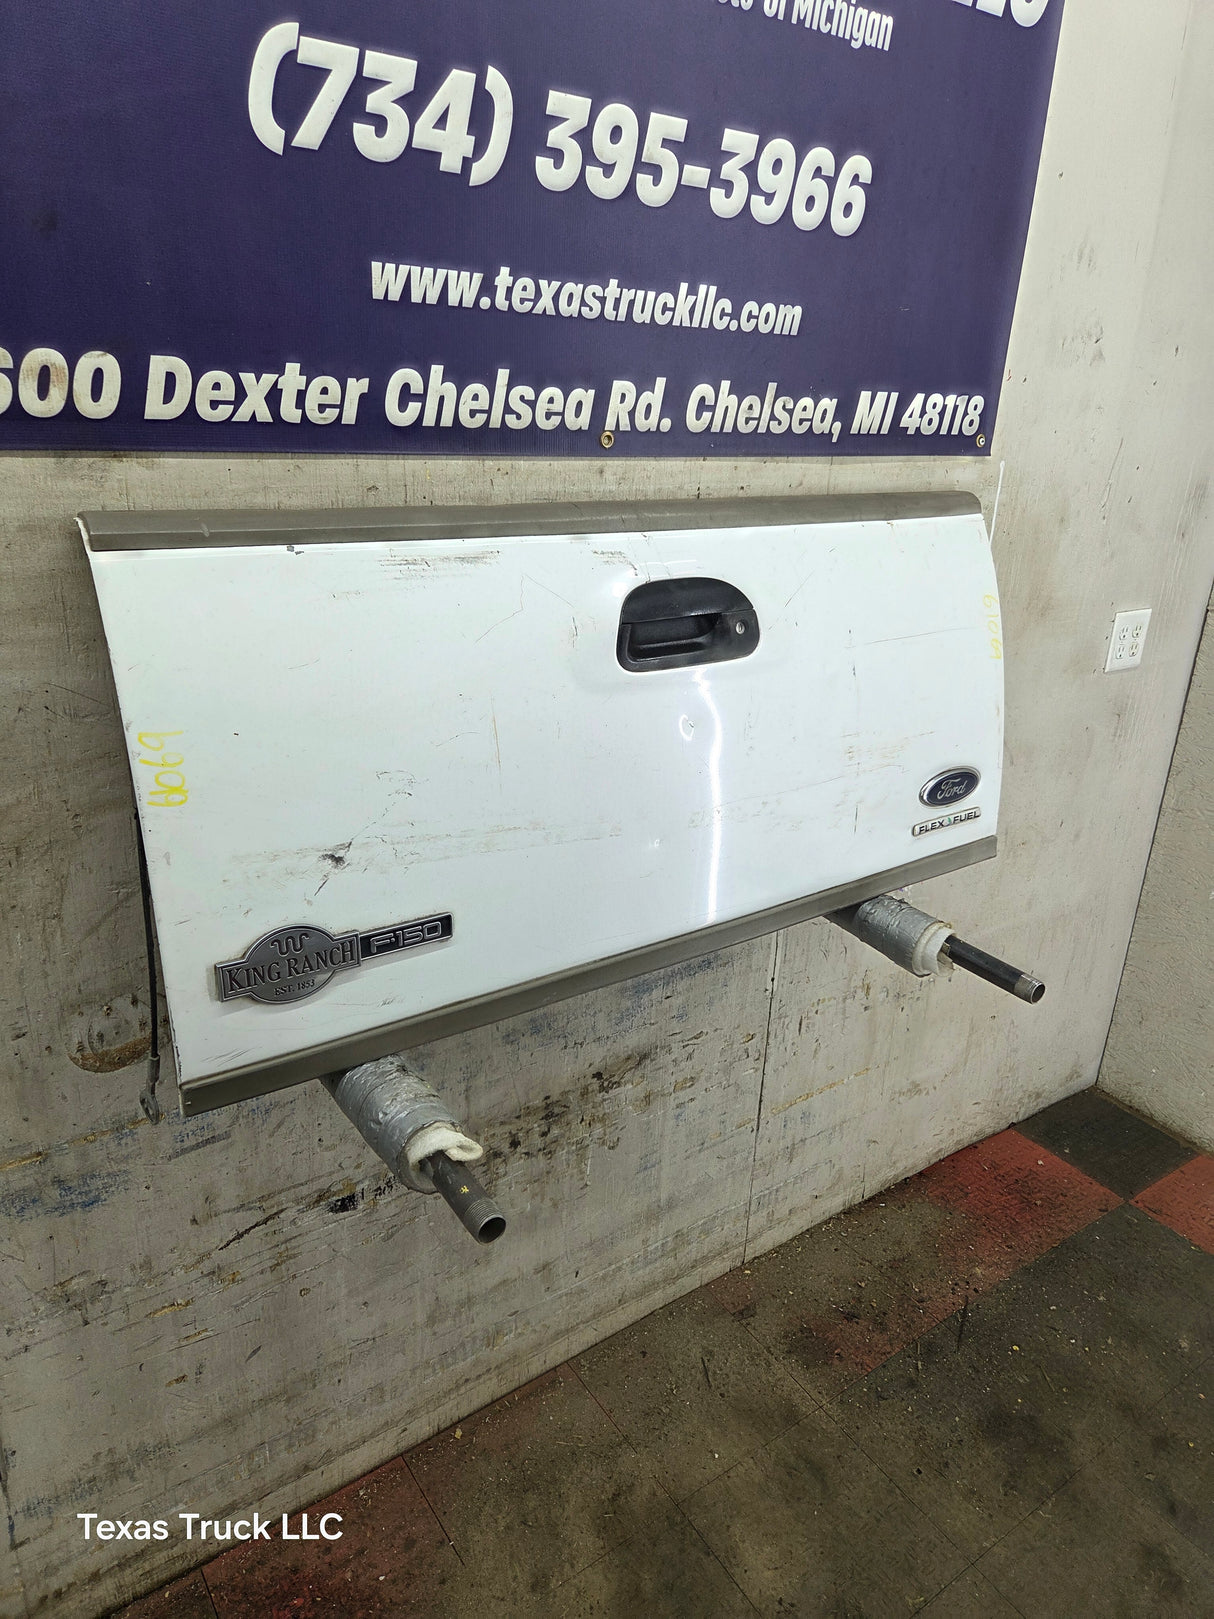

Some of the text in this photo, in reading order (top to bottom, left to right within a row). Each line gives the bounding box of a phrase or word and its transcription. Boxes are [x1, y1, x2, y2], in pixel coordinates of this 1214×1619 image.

[791, 0, 894, 52] Michigan
[248, 21, 874, 238] (734) 395-3966
[370, 260, 803, 337] www.texastruckllc.com
[0, 346, 985, 443] 00 Dexter Chelsea Rd. Chelsea, MI 48118
[937, 777, 968, 800] Ford
[918, 811, 980, 835] FLEX FUEL
[226, 939, 356, 993] KING RANCH
[274, 978, 316, 997] EST. 1853
